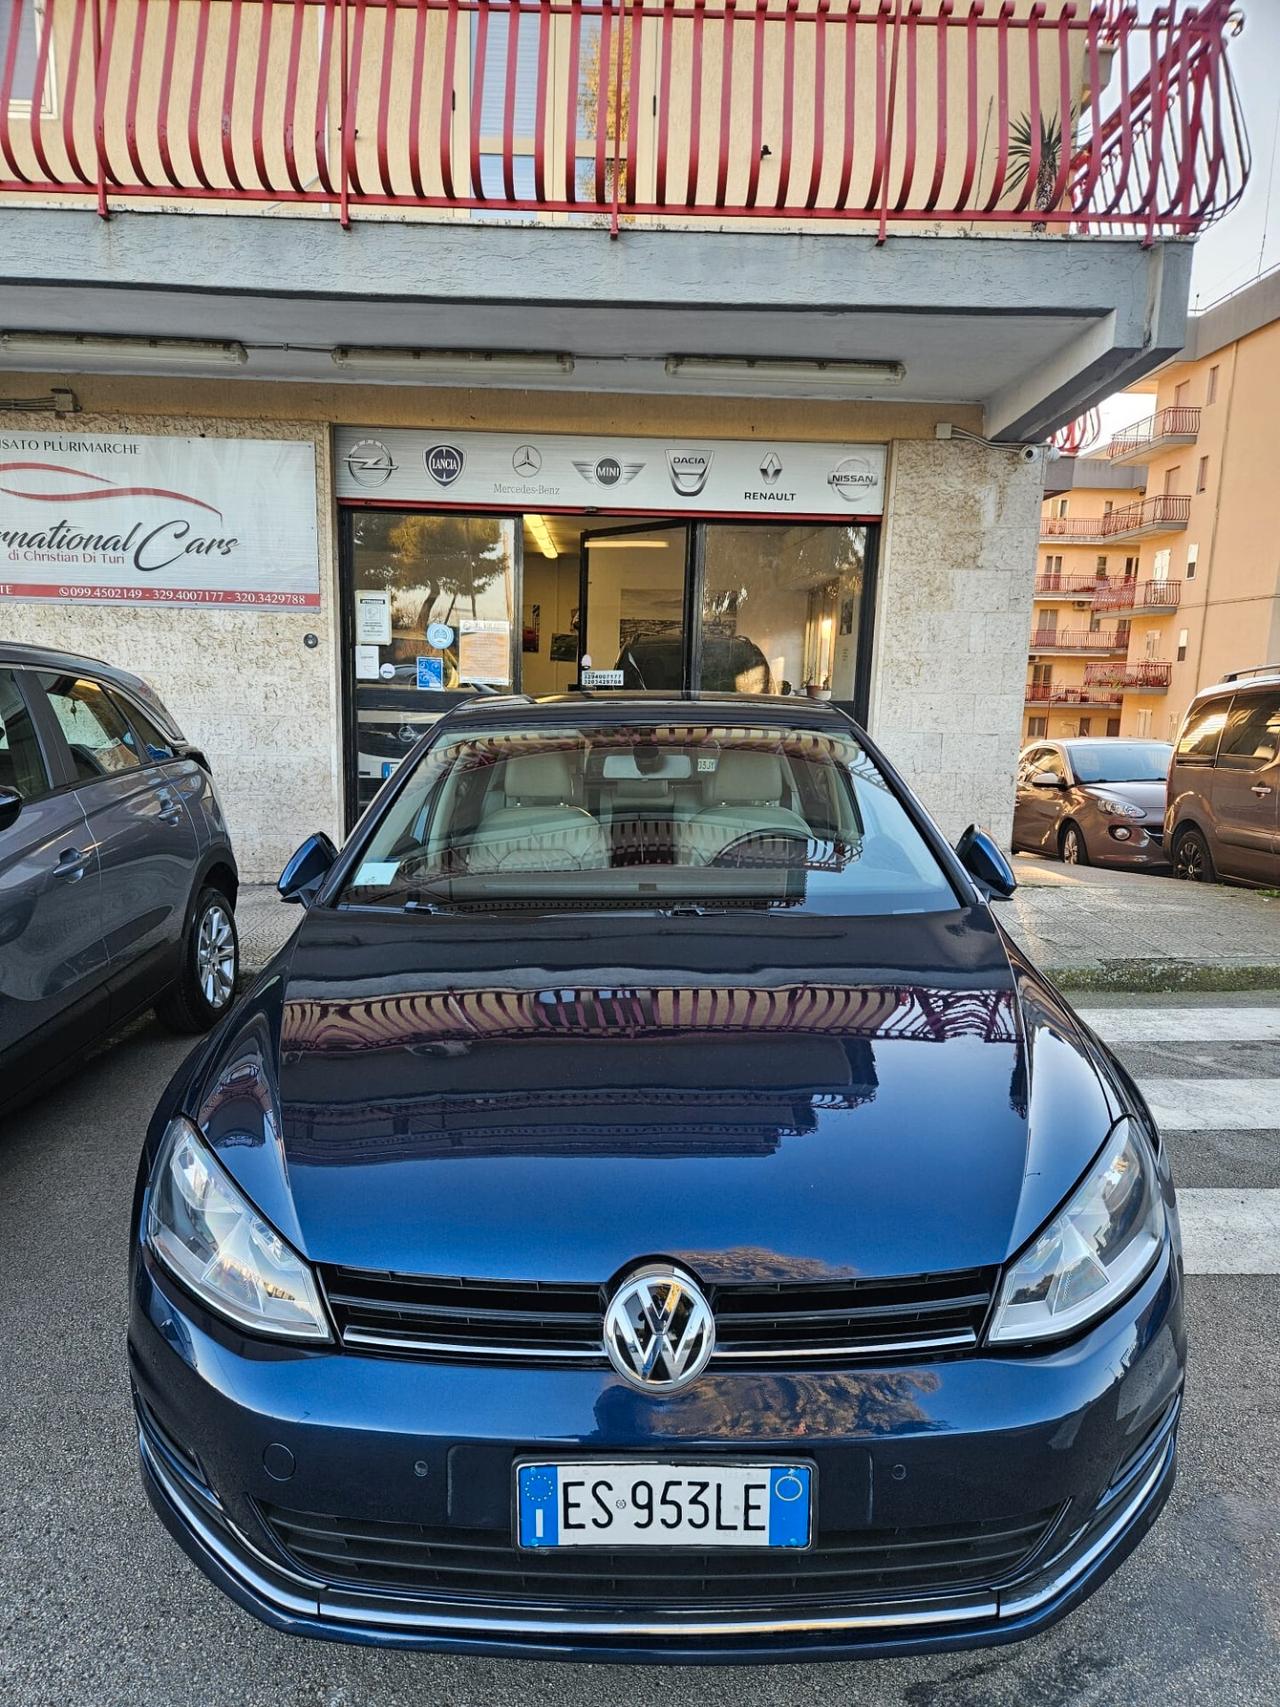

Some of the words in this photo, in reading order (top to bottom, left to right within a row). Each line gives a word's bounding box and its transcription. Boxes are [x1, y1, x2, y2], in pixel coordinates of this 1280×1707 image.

[0, 439, 39, 450] SATO
[44, 440, 141, 454] PLURIMARCHE
[432, 458, 458, 470] LANCIA
[673, 456, 706, 465] DACIA
[597, 467, 620, 477] MINI
[832, 474, 874, 483] NISSAN
[493, 483, 561, 496] Mercedes-Benz
[744, 491, 796, 501] RENAULT
[133, 519, 241, 572] Cars
[8, 549, 19, 561] di
[23, 550, 79, 562] Christian
[82, 552, 97, 563] Di
[100, 553, 125, 564] Turi
[70, 587, 142, 599] 099.4502149
[153, 589, 224, 602] 329.4007177
[234, 592, 305, 605] 320.3429788
